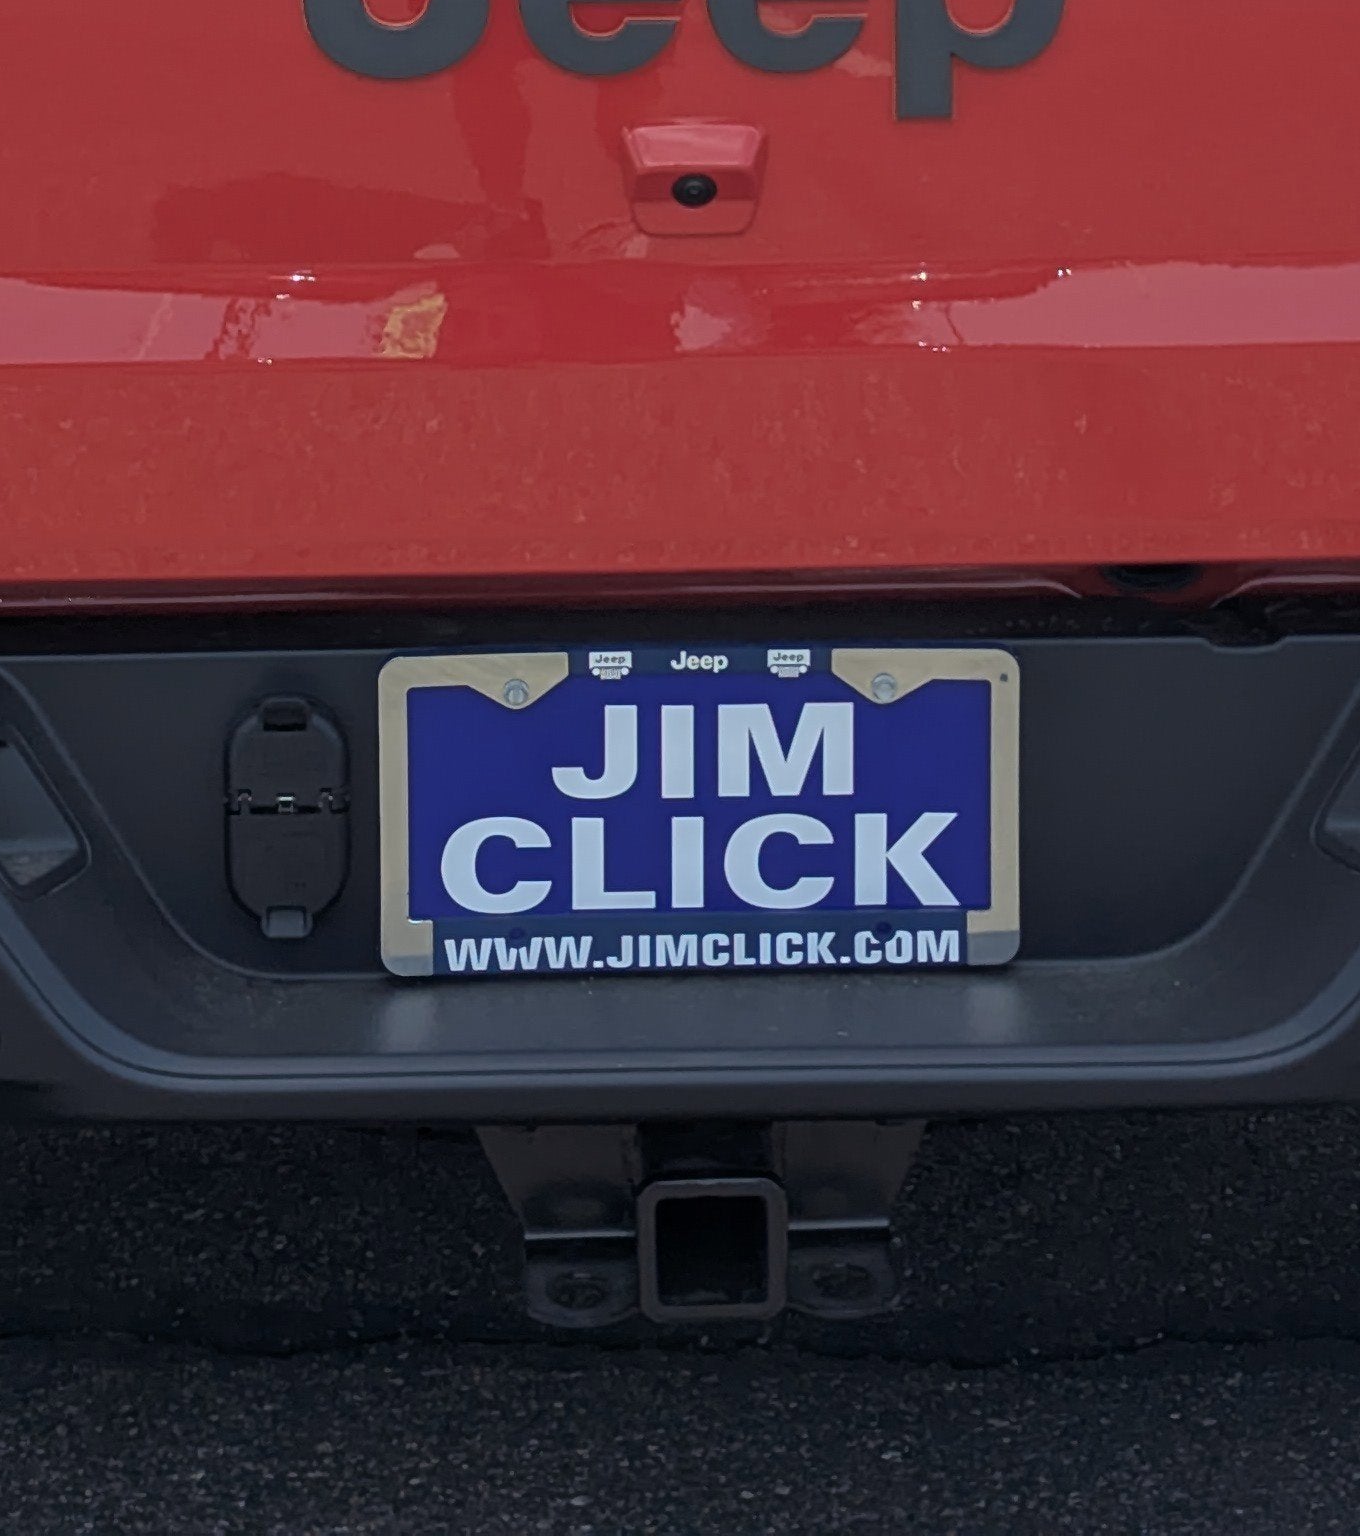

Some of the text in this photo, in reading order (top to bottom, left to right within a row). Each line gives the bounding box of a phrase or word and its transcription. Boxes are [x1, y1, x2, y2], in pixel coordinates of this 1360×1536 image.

[594, 653, 627, 665] Jeep
[670, 650, 729, 674] Jeep
[772, 652, 805, 663] Jeep
[551, 702, 854, 799] JIM
[440, 812, 961, 914] CLICK
[443, 930, 960, 972] WWW.JIMCLICK.COM
